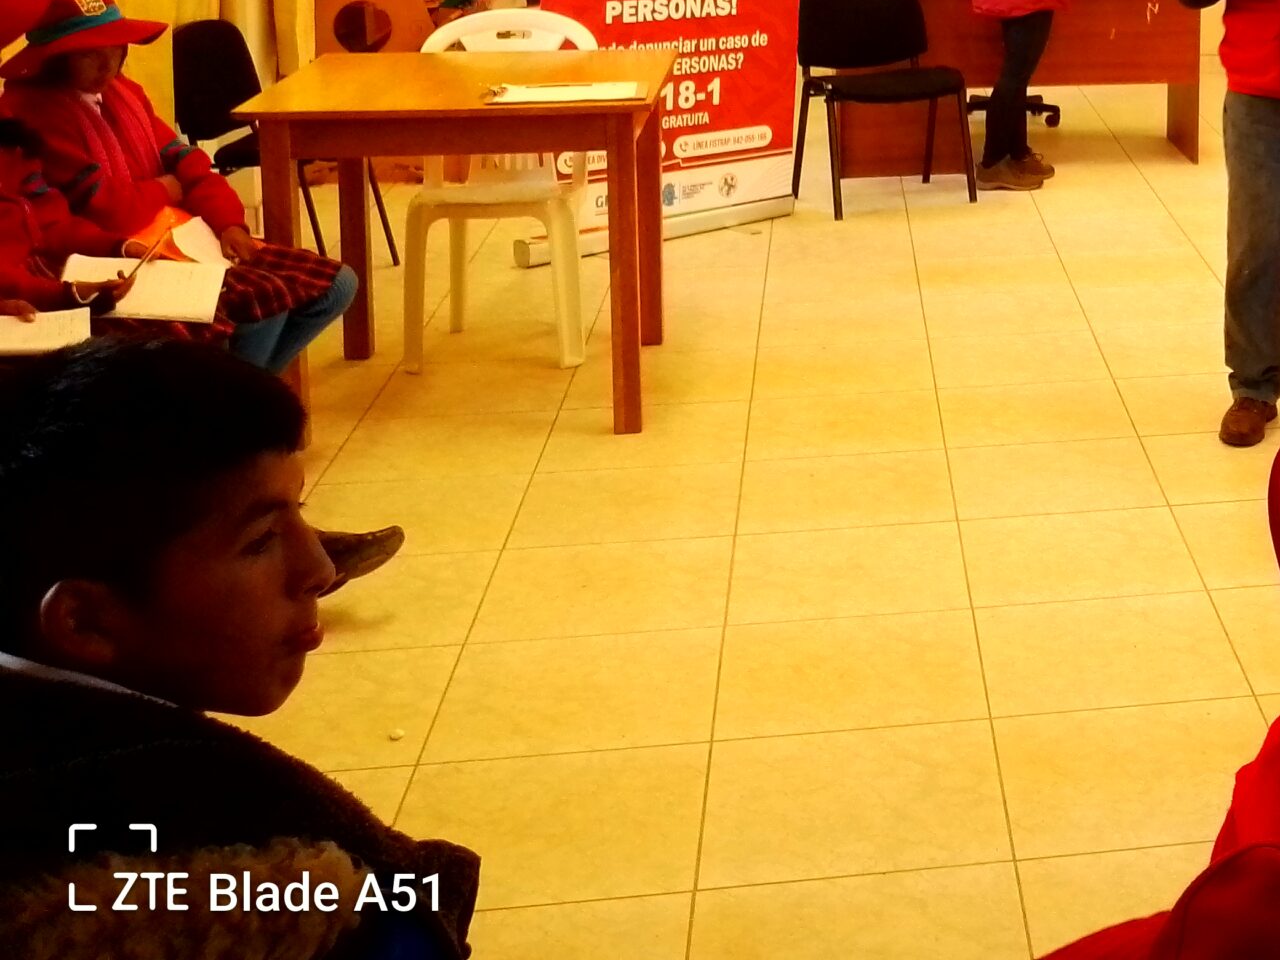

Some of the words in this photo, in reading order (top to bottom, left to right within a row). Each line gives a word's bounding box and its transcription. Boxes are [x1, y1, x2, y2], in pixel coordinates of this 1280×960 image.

[700, 37, 717, 52] un
[719, 35, 749, 51] caso
[751, 30, 768, 47] de
[673, 52, 744, 76] ERSONAS?
[660, 77, 721, 111] 18-1
[661, 112, 710, 129] GRATUITA
